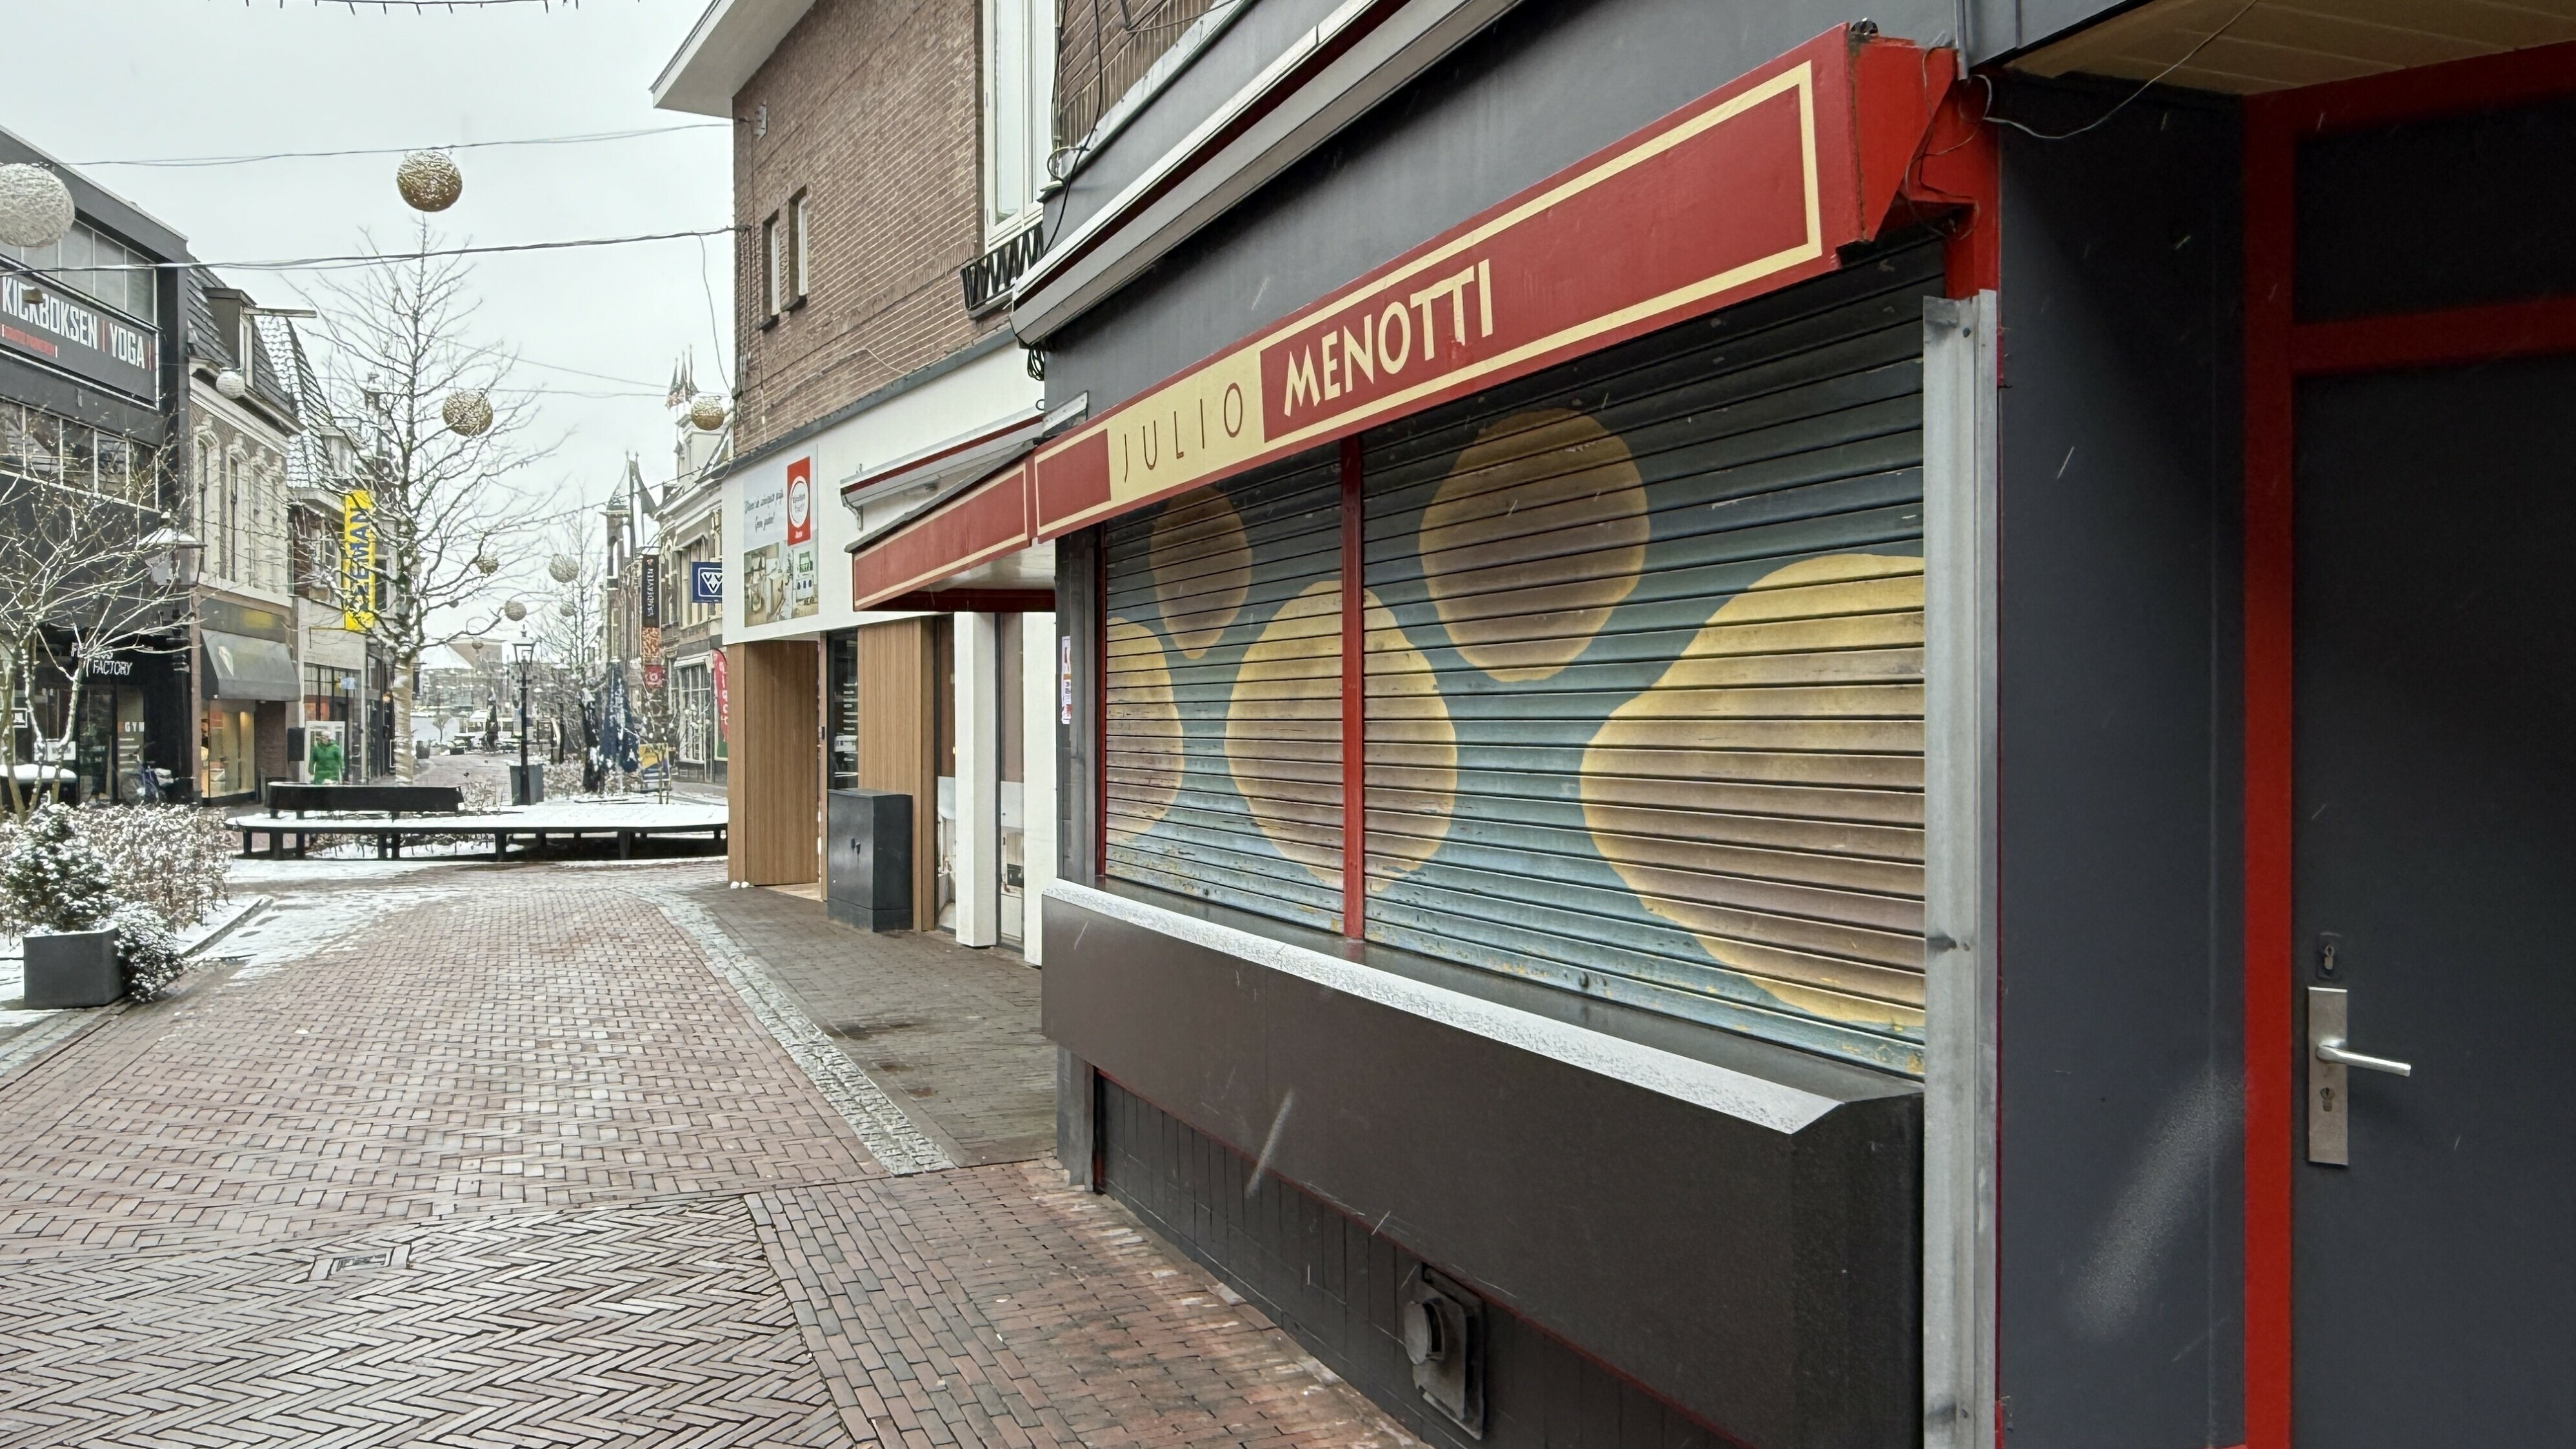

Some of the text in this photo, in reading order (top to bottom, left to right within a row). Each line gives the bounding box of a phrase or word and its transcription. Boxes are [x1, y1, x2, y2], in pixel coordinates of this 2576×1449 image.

[109, 322, 146, 370] YOGA
[1124, 258, 1493, 483] JULIO MENOTTI
[350, 506, 370, 613] EMAN
[92, 659, 133, 676] FACTORY
